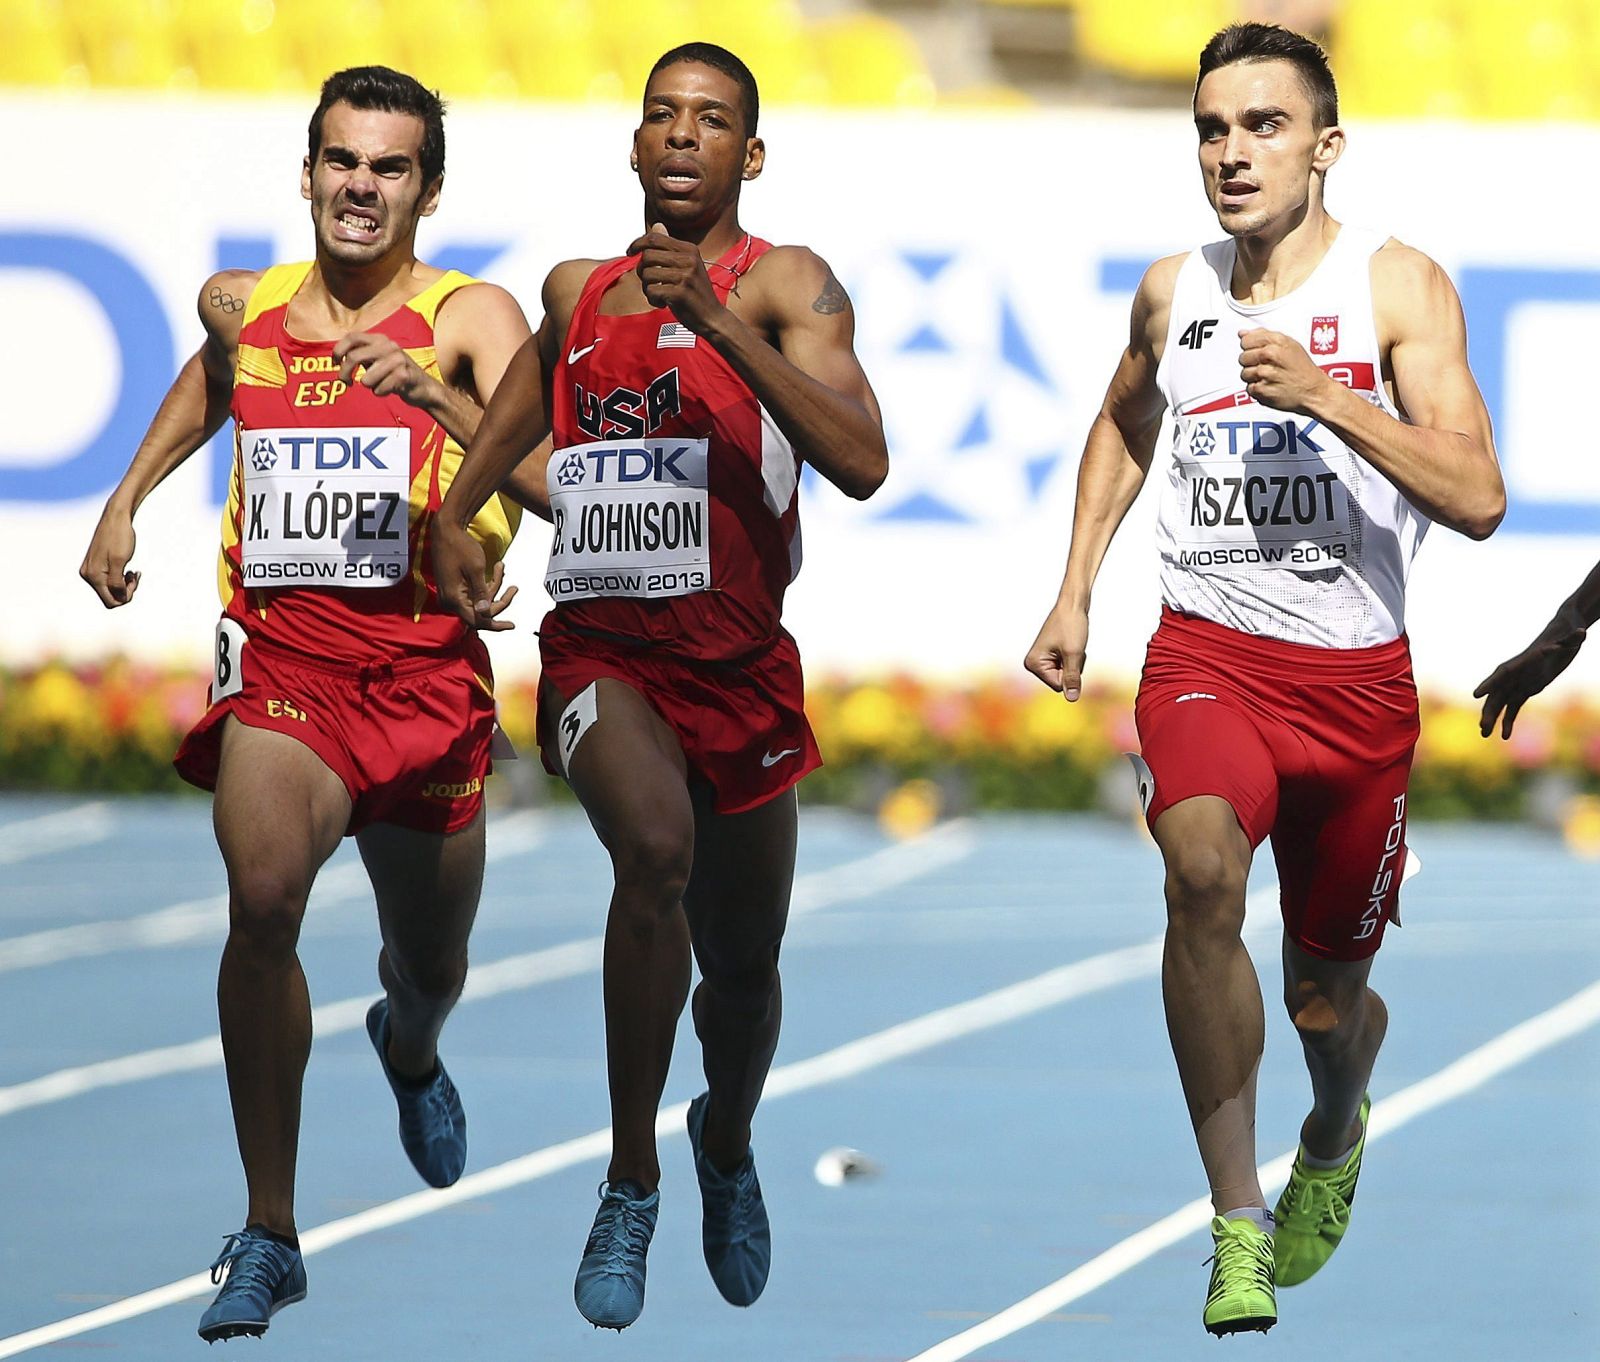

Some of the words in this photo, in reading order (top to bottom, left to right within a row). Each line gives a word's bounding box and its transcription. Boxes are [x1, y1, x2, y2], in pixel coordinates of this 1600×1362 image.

[1179, 319, 1219, 349] 4F
[294, 380, 346, 407] ESP
[575, 367, 681, 440] USA
[279, 437, 389, 470] TDK
[1216, 420, 1326, 455] TDK
[587, 447, 689, 483] TDK
[248, 493, 269, 541] K.
[284, 480, 400, 540] LÓPEZ
[1190, 473, 1338, 527] KSZCZOT
[572, 501, 701, 554] JOHNSON
[242, 563, 337, 579] MOSCOW
[344, 563, 400, 579] 2013
[1180, 548, 1283, 566] MOSCOW
[1290, 543, 1347, 563] 2013
[546, 576, 641, 595] MOSCOW
[647, 572, 705, 591] 2013
[218, 631, 231, 688] 8
[562, 710, 581, 752] 3
[1352, 793, 1405, 940] POLSKA
